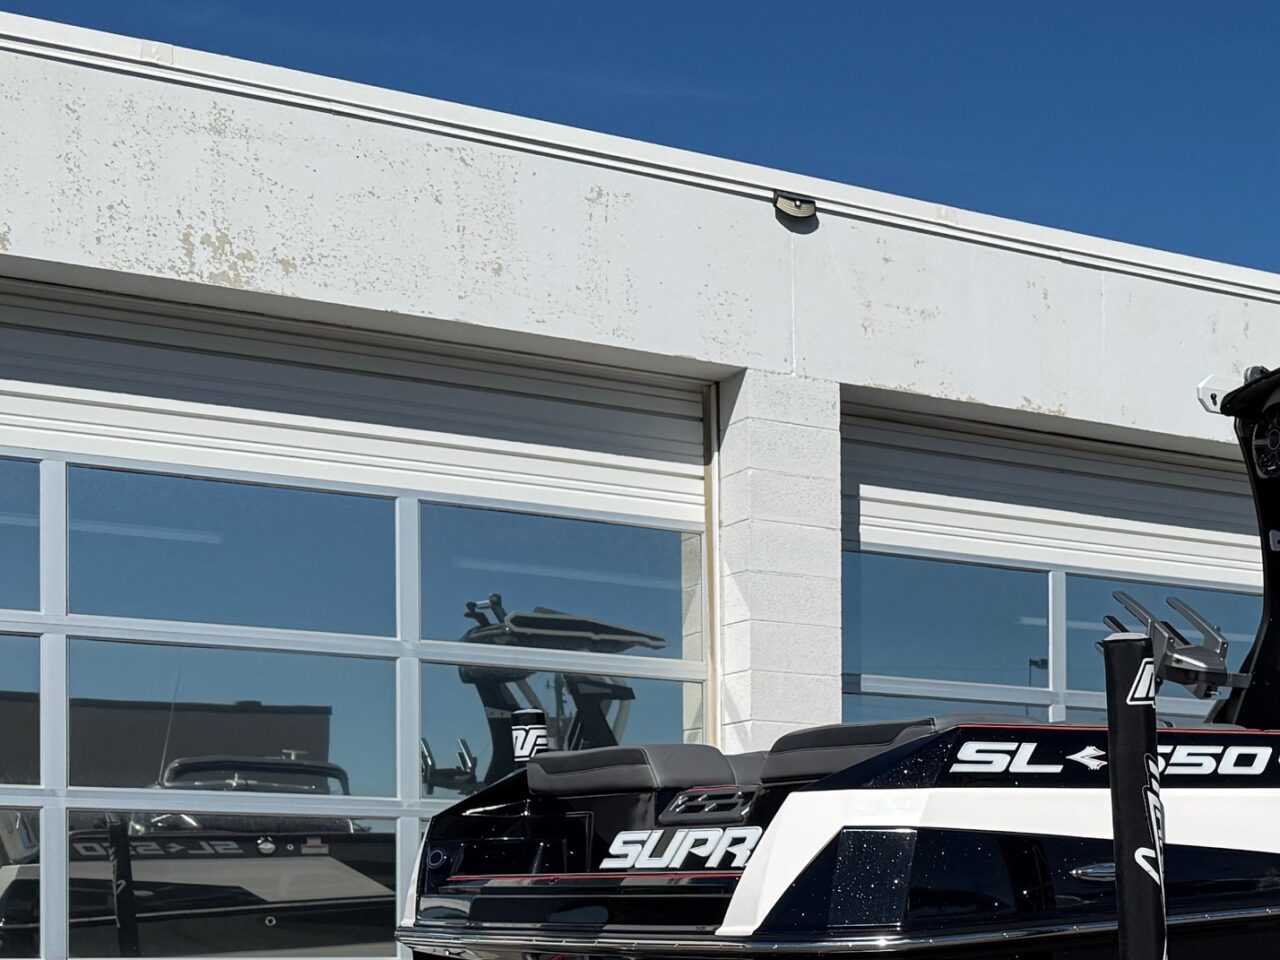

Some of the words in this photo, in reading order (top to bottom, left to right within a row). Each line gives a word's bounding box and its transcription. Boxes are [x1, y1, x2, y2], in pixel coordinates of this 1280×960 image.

[950, 741, 1063, 773] SL
[1157, 745, 1273, 775] 50
[599, 826, 763, 869] SUPR
